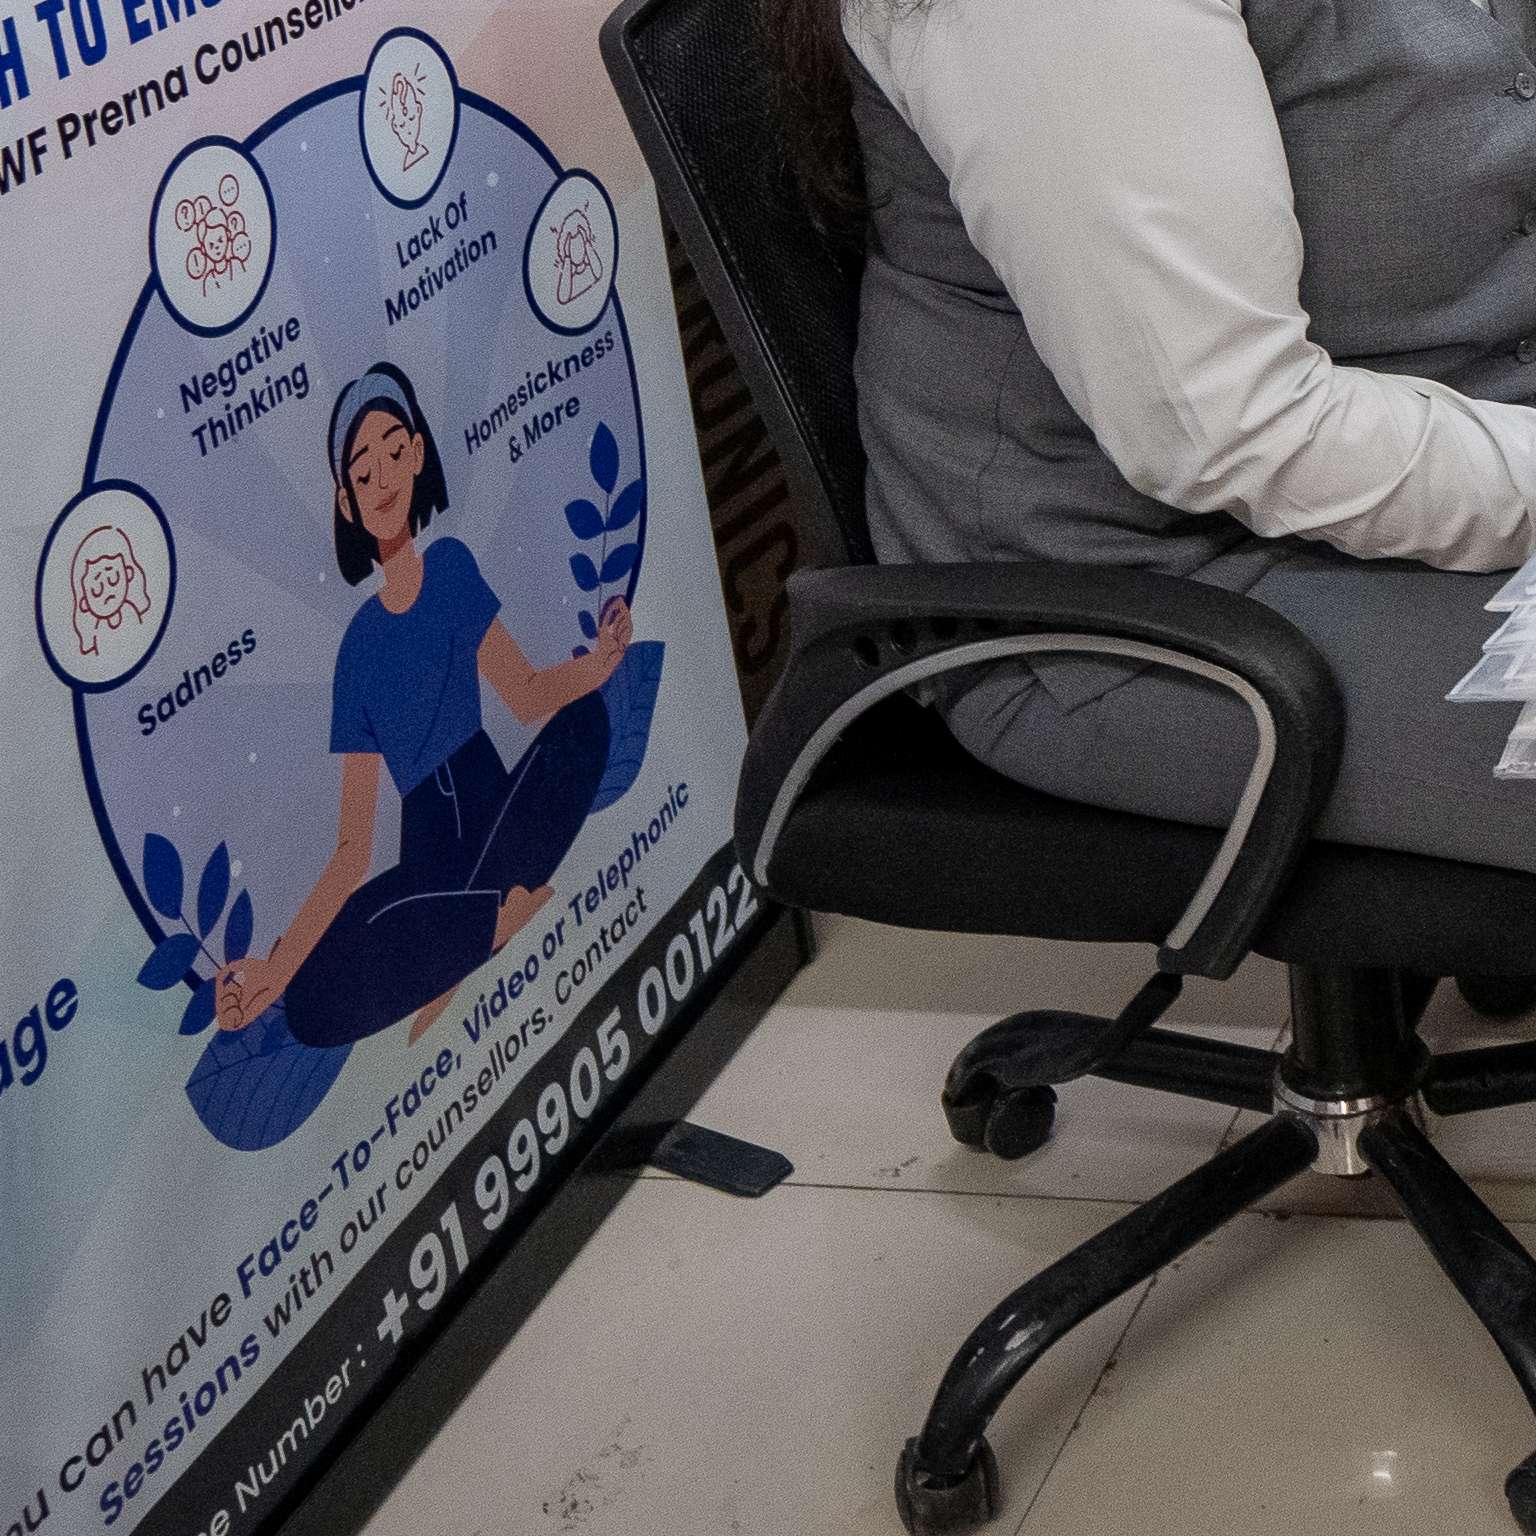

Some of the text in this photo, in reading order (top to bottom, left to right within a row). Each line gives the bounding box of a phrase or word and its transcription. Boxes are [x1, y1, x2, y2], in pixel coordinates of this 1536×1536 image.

[61, 63, 189, 154] Prerna
[384, 229, 498, 326] Motivation
[396, 192, 468, 268] Lack Of
[178, 316, 302, 416] Negative
[191, 362, 311, 458] Thinking
[463, 330, 616, 456] Homesickness
[523, 395, 582, 450] More
[137, 627, 258, 737] Sadness
[58, 1398, 138, 1495] can
[142, 1290, 233, 1407] have
[236, 1049, 464, 1301] Face-To-Face,
[462, 950, 540, 1046] Video
[541, 915, 567, 964] or
[568, 782, 690, 927] Telephonic
[376, 1213, 470, 1344] +91
[474, 1007, 632, 1232] 99905
[100, 1335, 261, 1528] Sessions
[263, 1245, 335, 1340] with
[339, 1192, 390, 1252] our
[396, 1011, 555, 1188] counsellors.
[553, 887, 648, 1006] Contact
